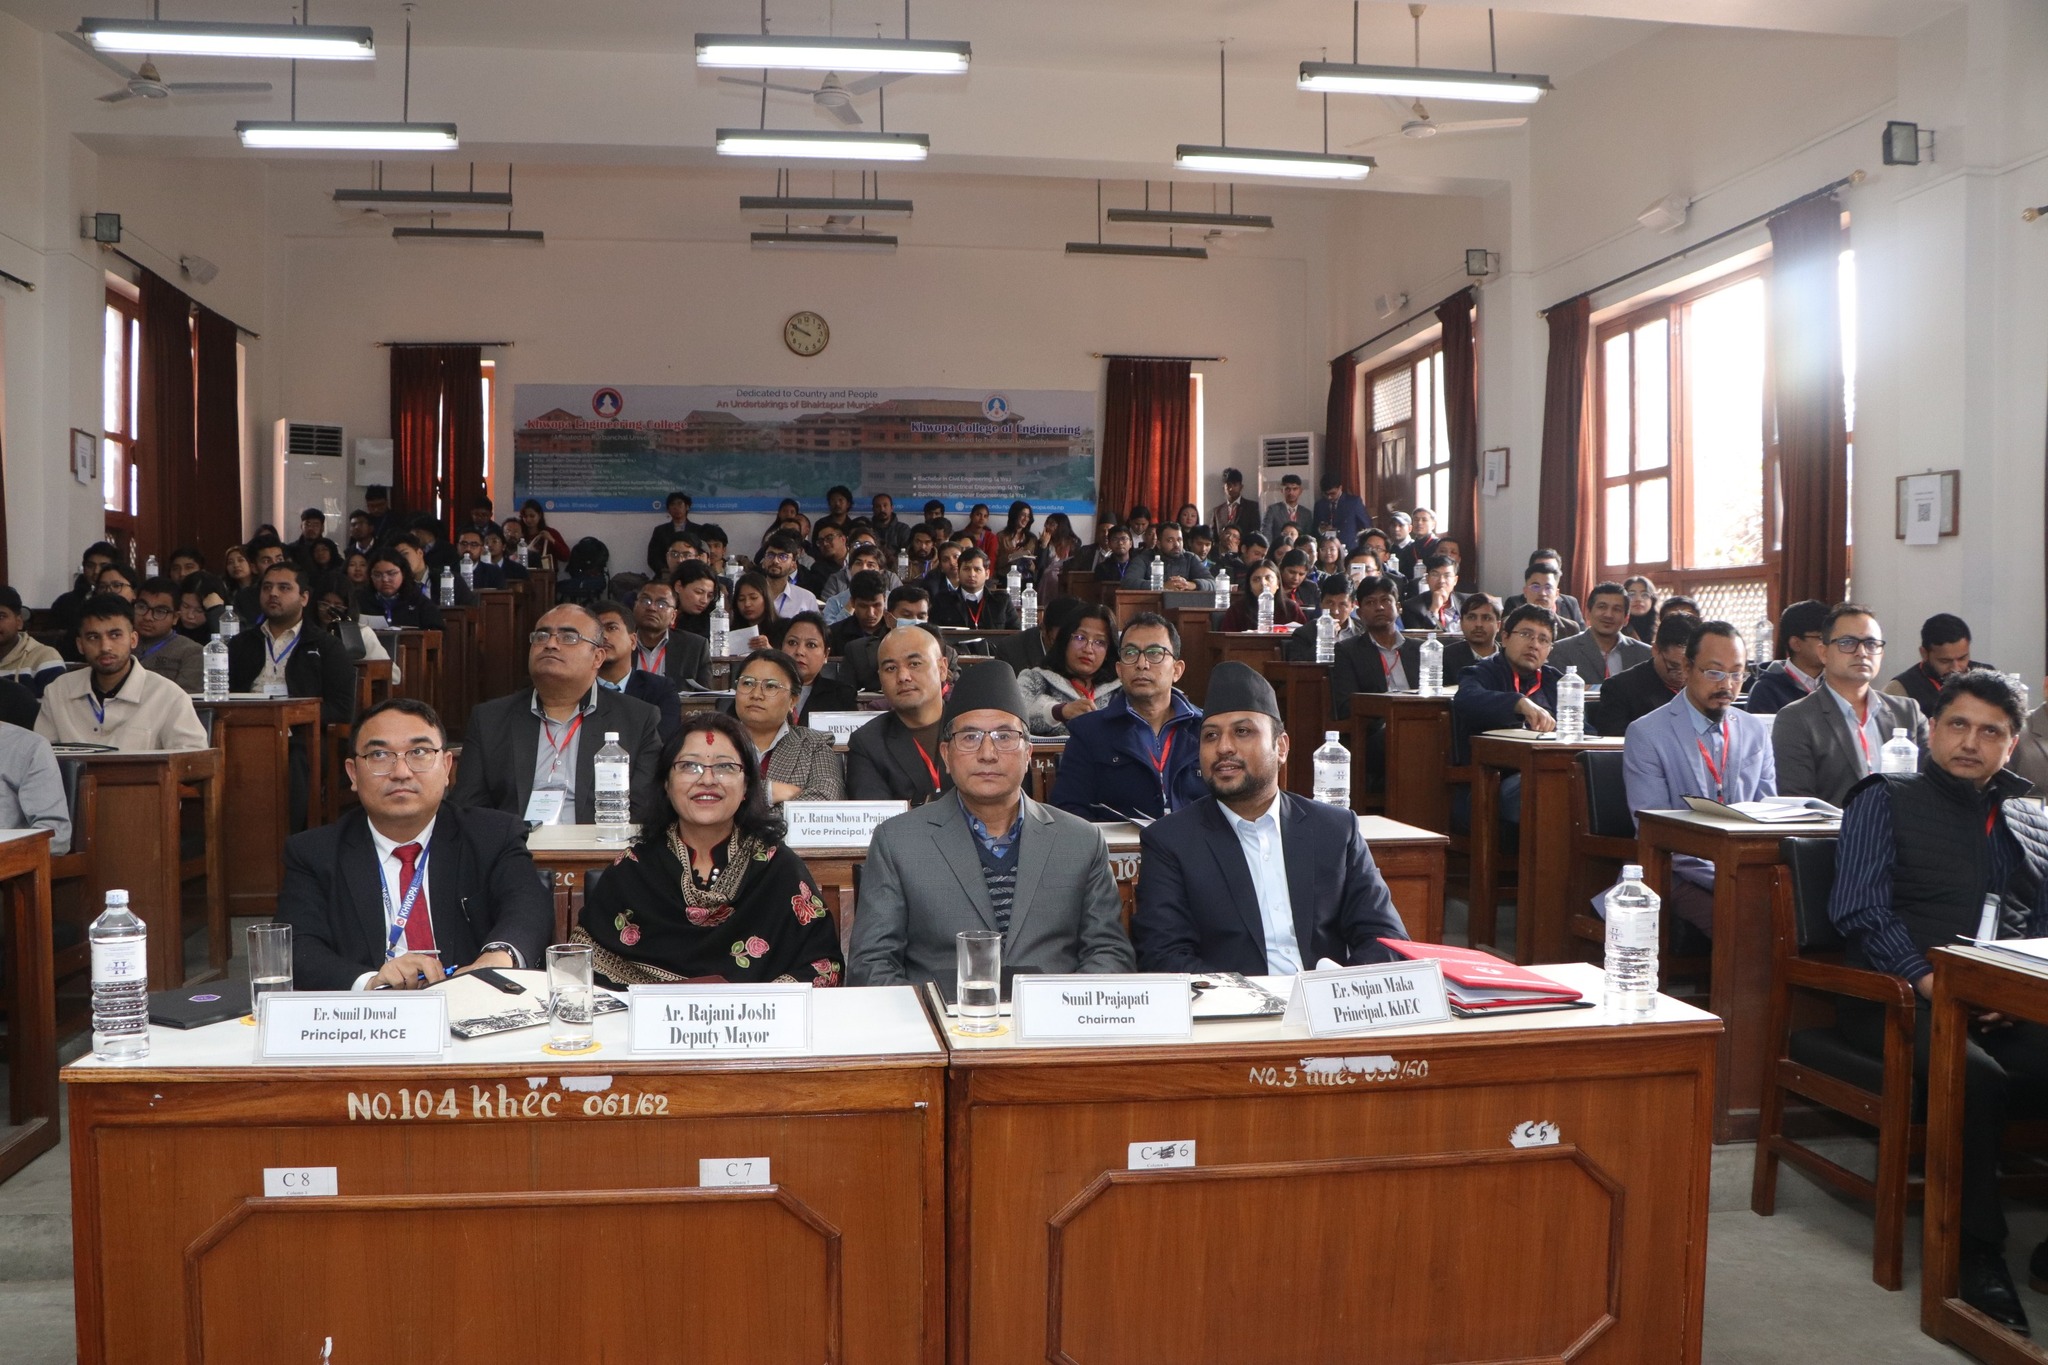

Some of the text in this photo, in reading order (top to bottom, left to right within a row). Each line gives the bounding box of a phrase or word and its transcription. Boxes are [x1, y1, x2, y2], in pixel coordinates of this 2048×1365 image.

[736, 388, 879, 400] Dedicated to Country and People
[716, 400, 729, 408] An
[730, 400, 789, 410] Undertakings
[790, 401, 800, 409] of
[800, 401, 845, 411] Bhaktapur
[527, 419, 688, 431] Khwopa Engineering College
[911, 421, 1082, 437] Khwopa College of Engineering
[793, 812, 805, 823] Er.
[809, 812, 834, 823] Ratna
[836, 812, 861, 823] Shova
[801, 828, 822, 836] Vice
[823, 828, 867, 837] Principal,
[400, 886, 419, 917] KHWOPA
[1331, 975, 1415, 1000] Er. Sujan Maka
[1061, 991, 1150, 1009] Sunil Prajapati
[313, 1007, 397, 1021] Er. Sunil Duwal
[662, 1003, 776, 1026] Ar. Rajani Joshi
[1333, 997, 1422, 1024] Principal, KhEC
[1077, 1015, 1135, 1024] Chairman
[301, 1028, 406, 1043] Principal, KhCE
[670, 1026, 770, 1049] Deputy Mayor
[583, 1092, 670, 1116] 061/62
[1141, 1146, 1153, 1160] C
[724, 1162, 752, 1177] C 7
[282, 1172, 310, 1187] C 8
